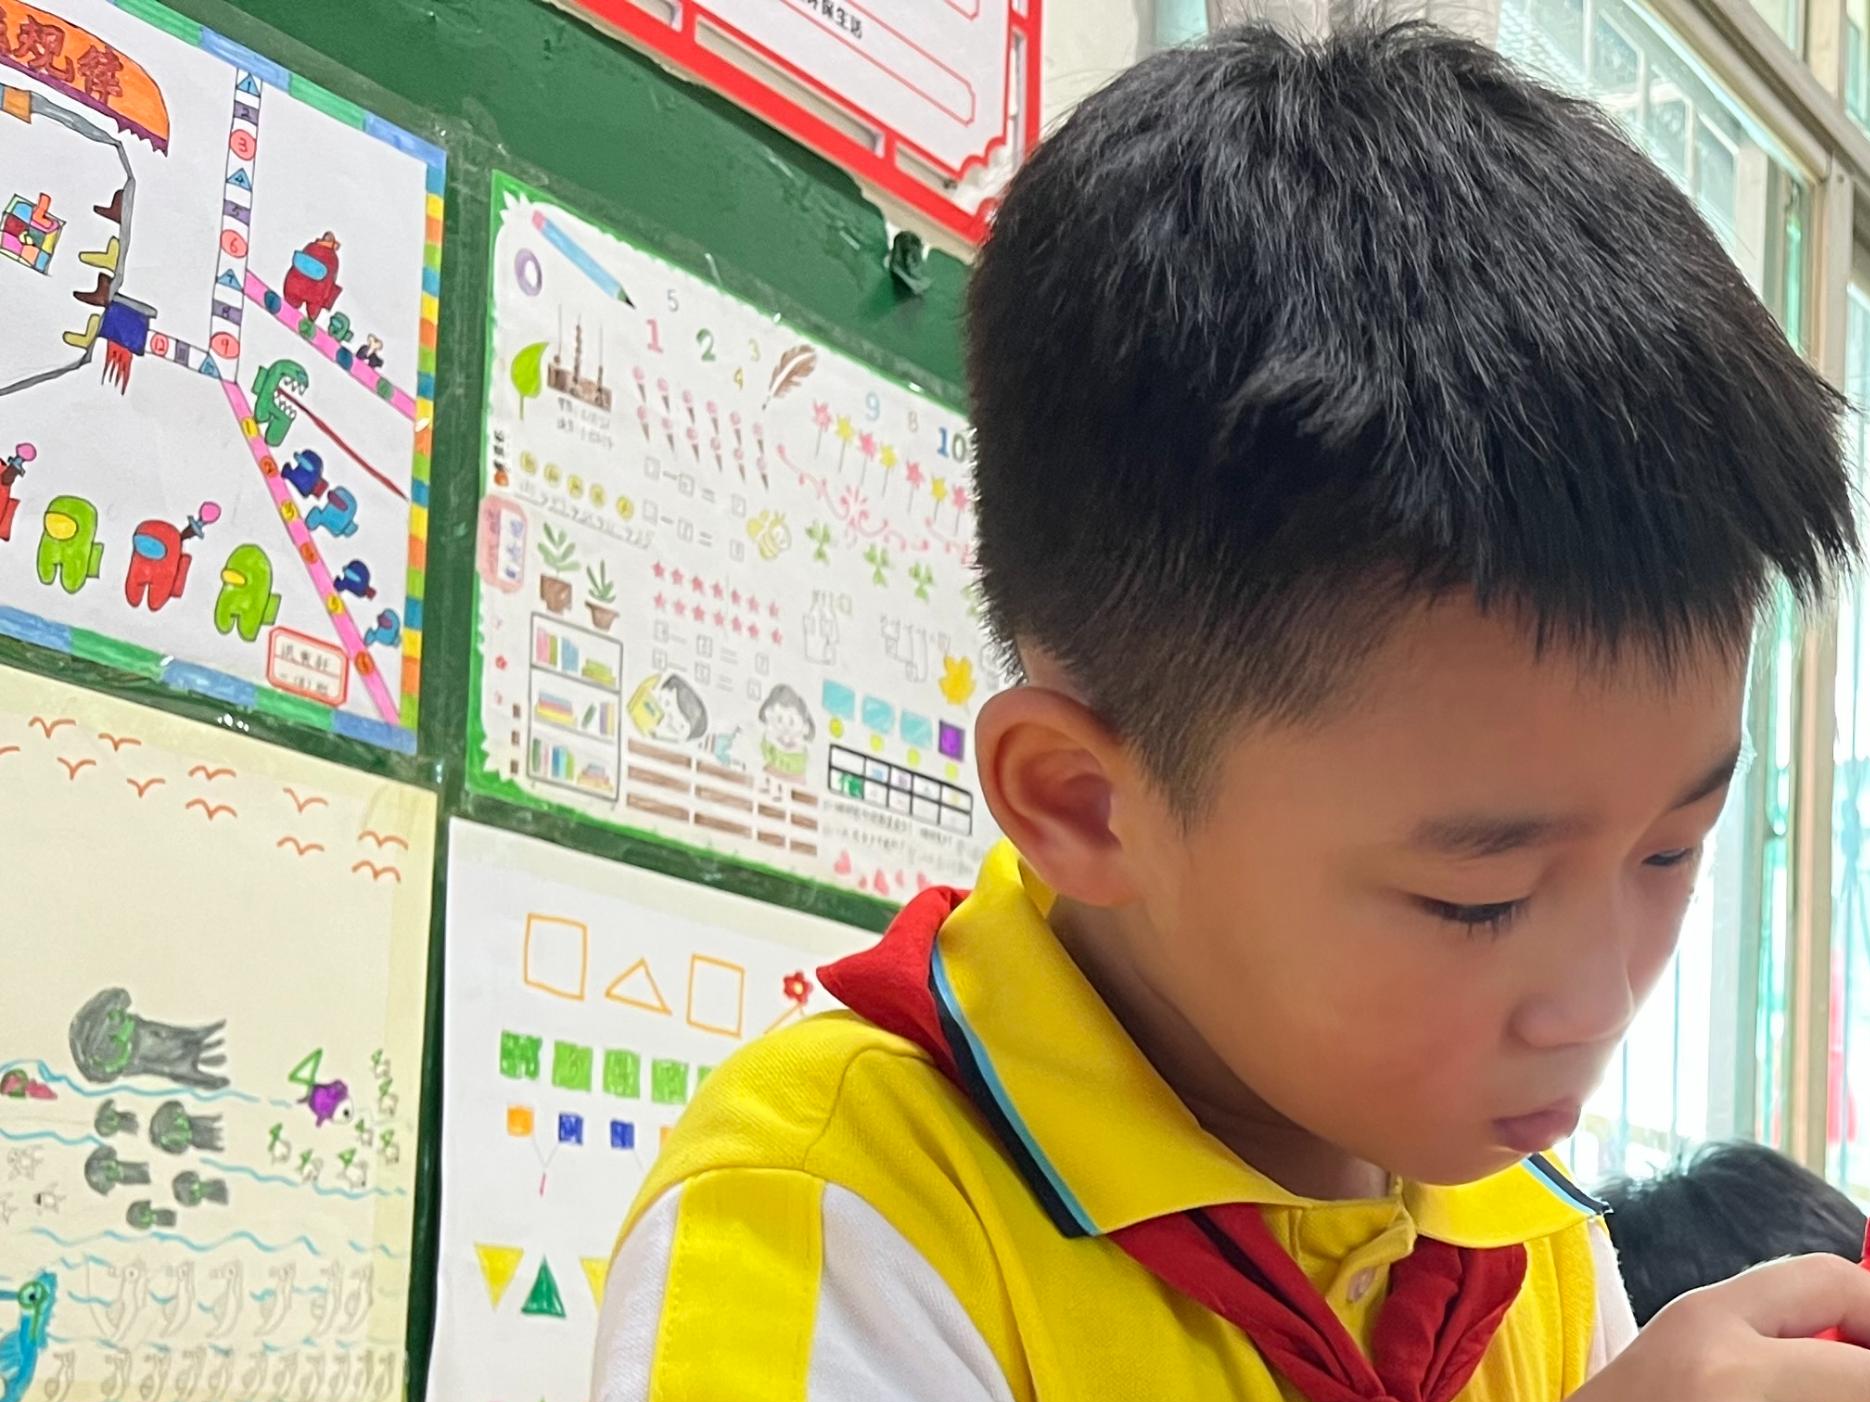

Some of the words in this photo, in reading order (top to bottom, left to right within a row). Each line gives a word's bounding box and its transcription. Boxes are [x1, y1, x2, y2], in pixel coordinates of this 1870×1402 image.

[0, 6, 124, 105] 规律
[514, 247, 543, 297] 0
[666, 289, 679, 313] 5
[646, 318, 664, 354] 1
[695, 328, 717, 363] 2
[865, 391, 881, 423] 9
[937, 426, 968, 464] 10
